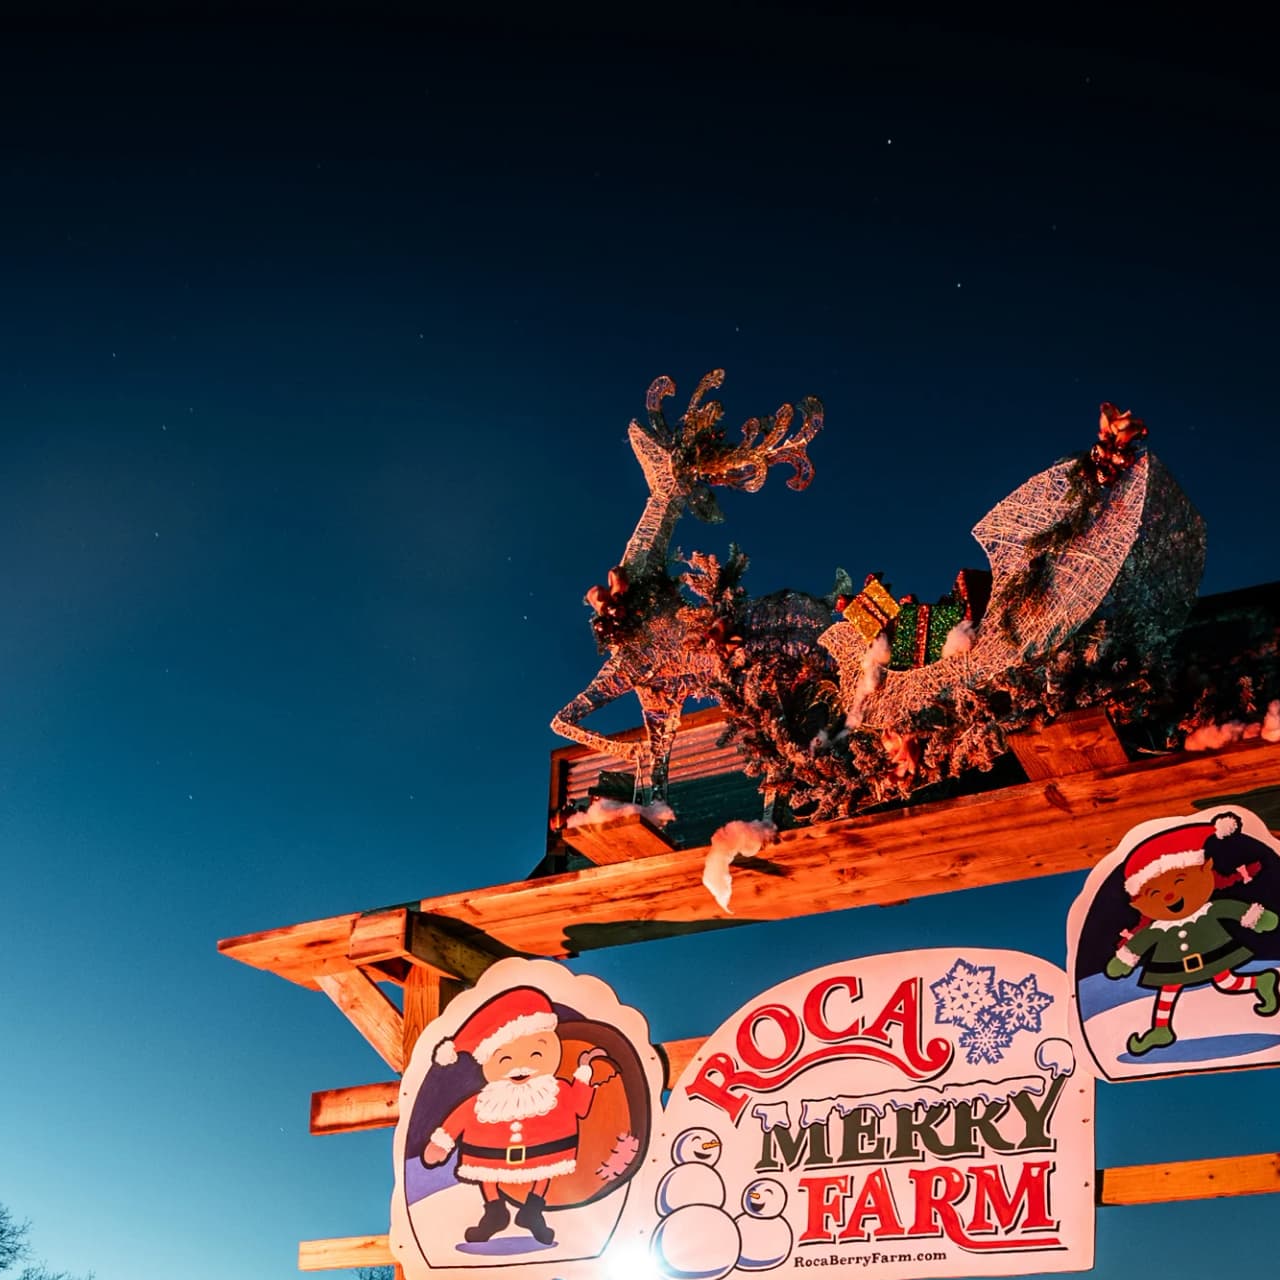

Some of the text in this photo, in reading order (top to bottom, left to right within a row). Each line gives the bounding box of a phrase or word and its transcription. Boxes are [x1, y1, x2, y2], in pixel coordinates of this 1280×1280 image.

[685, 976, 952, 1122] ROCA
[754, 1076, 1070, 1172] MERRY
[797, 1161, 1067, 1250] FARM
[794, 1252, 947, 1267] RocaBerryFarm.com
